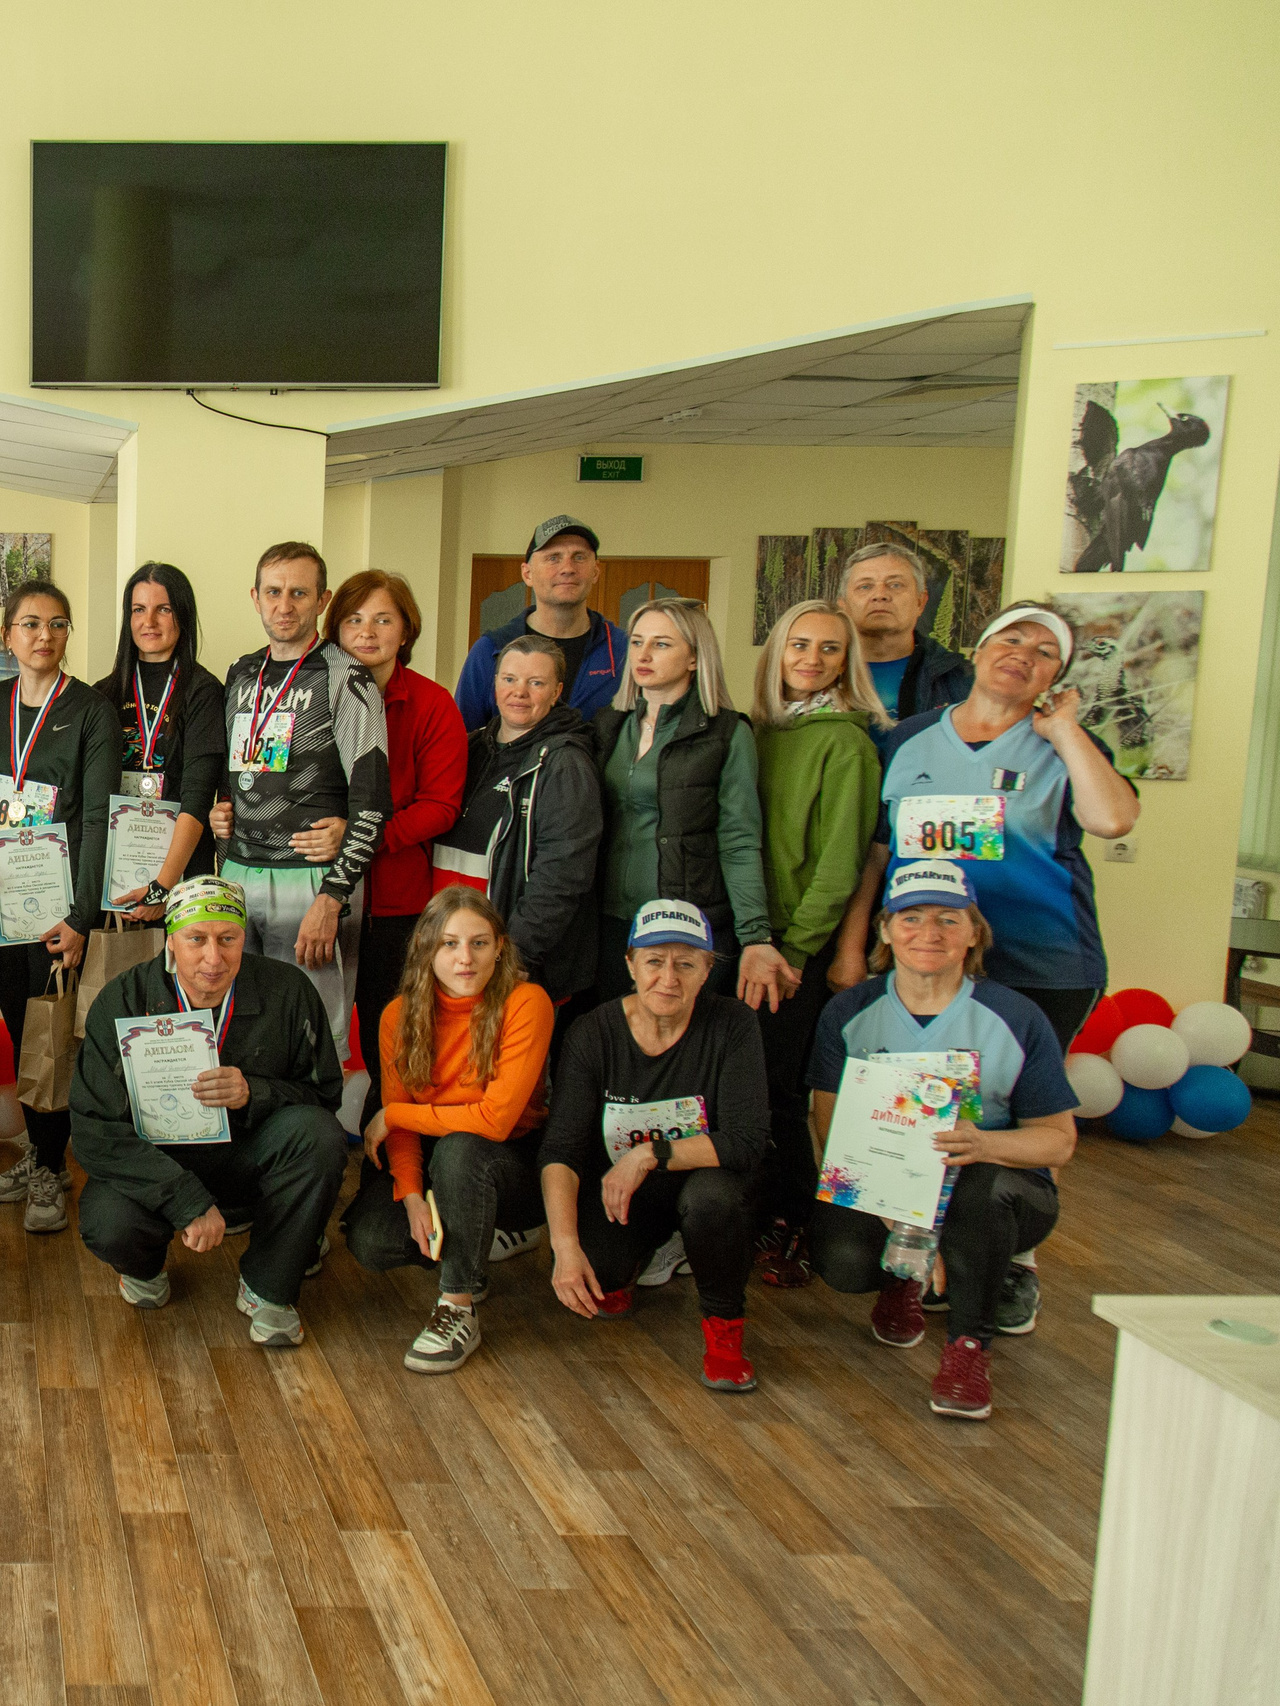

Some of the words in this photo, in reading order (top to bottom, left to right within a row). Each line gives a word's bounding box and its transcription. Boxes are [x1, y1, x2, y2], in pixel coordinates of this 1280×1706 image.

[596, 460, 626, 470] ВЫХОД
[128, 824, 167, 834] ДИПЛОМ
[921, 821, 975, 851] 805
[7, 852, 50, 864] ДИПЛОМ
[642, 910, 701, 928] ШЕРБАКУЛЬ
[144, 1044, 195, 1057] ДИПЛОМ
[871, 1109, 917, 1128] ДИПЛОМ
